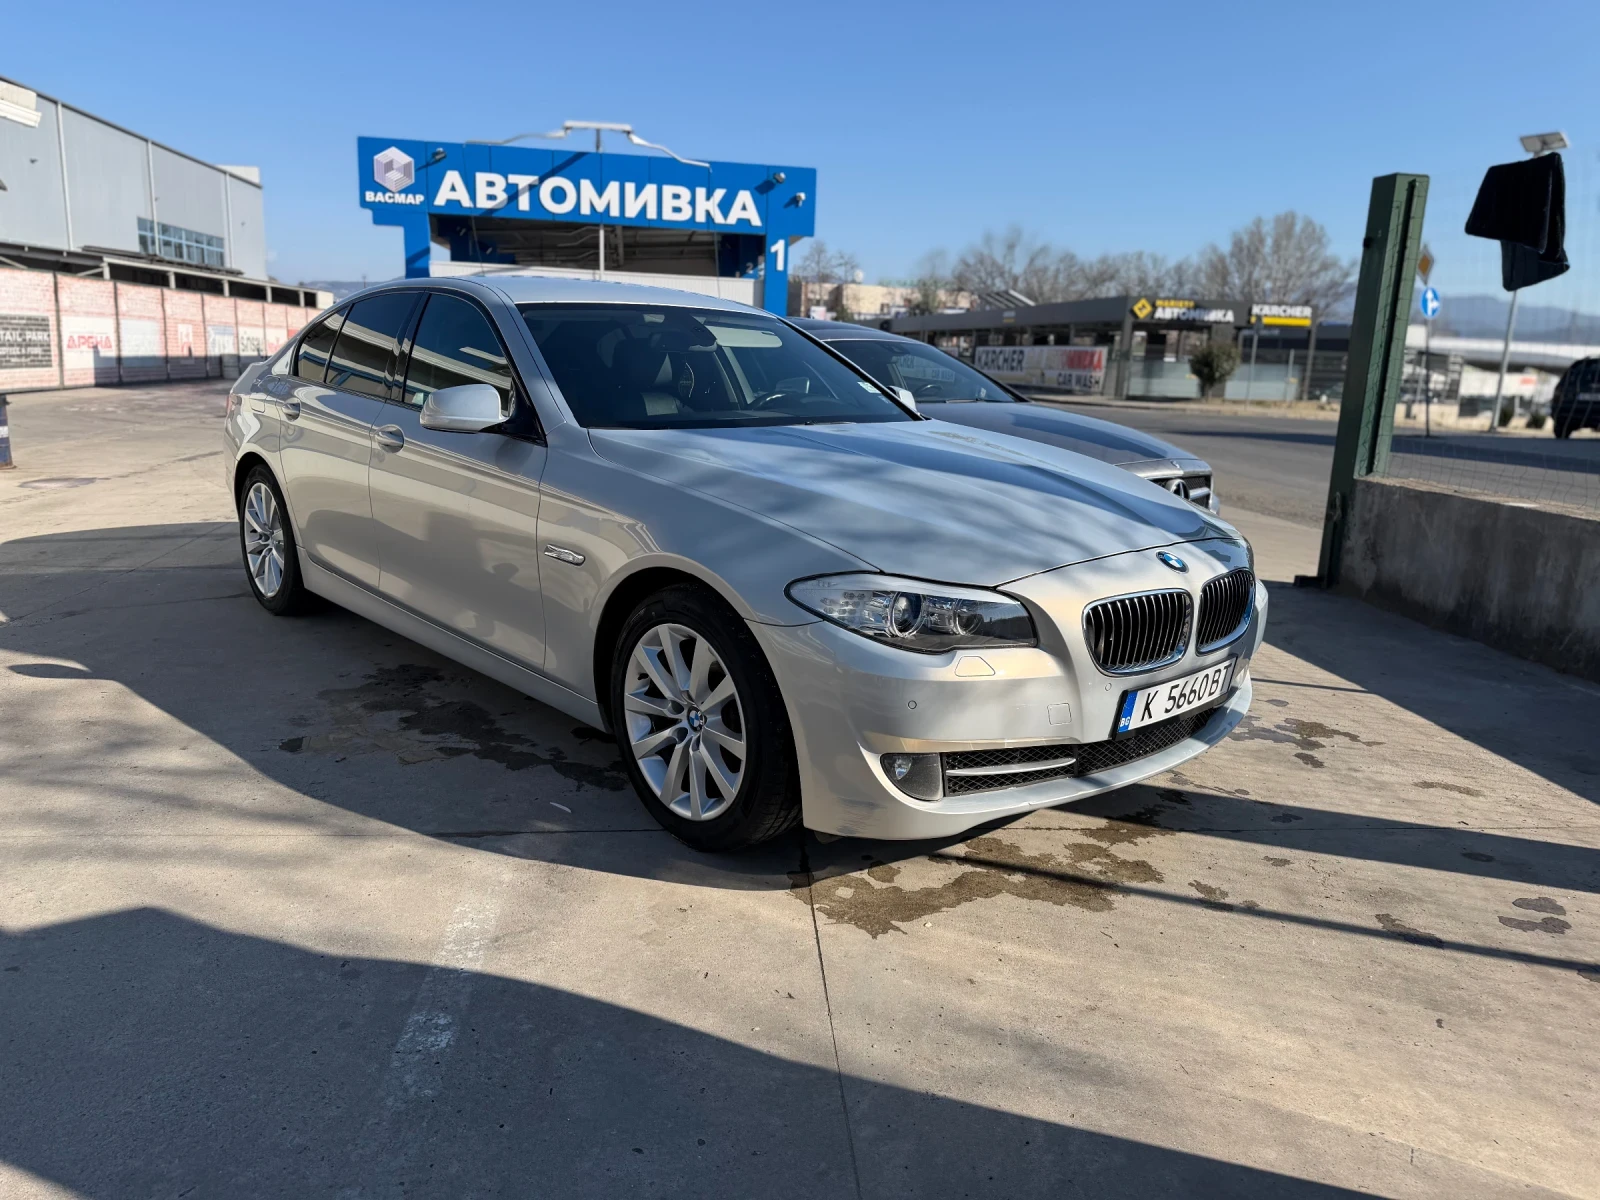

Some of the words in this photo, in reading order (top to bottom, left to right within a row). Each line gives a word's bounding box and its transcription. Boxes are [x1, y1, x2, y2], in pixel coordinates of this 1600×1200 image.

[365, 190, 425, 205] ВАСМАР
[433, 170, 762, 227] АВТОМИВКА
[770, 239, 785, 271] 1
[1057, 372, 1073, 386] CAR
[1140, 690, 1159, 722] K
[1119, 716, 1130, 728] BG
